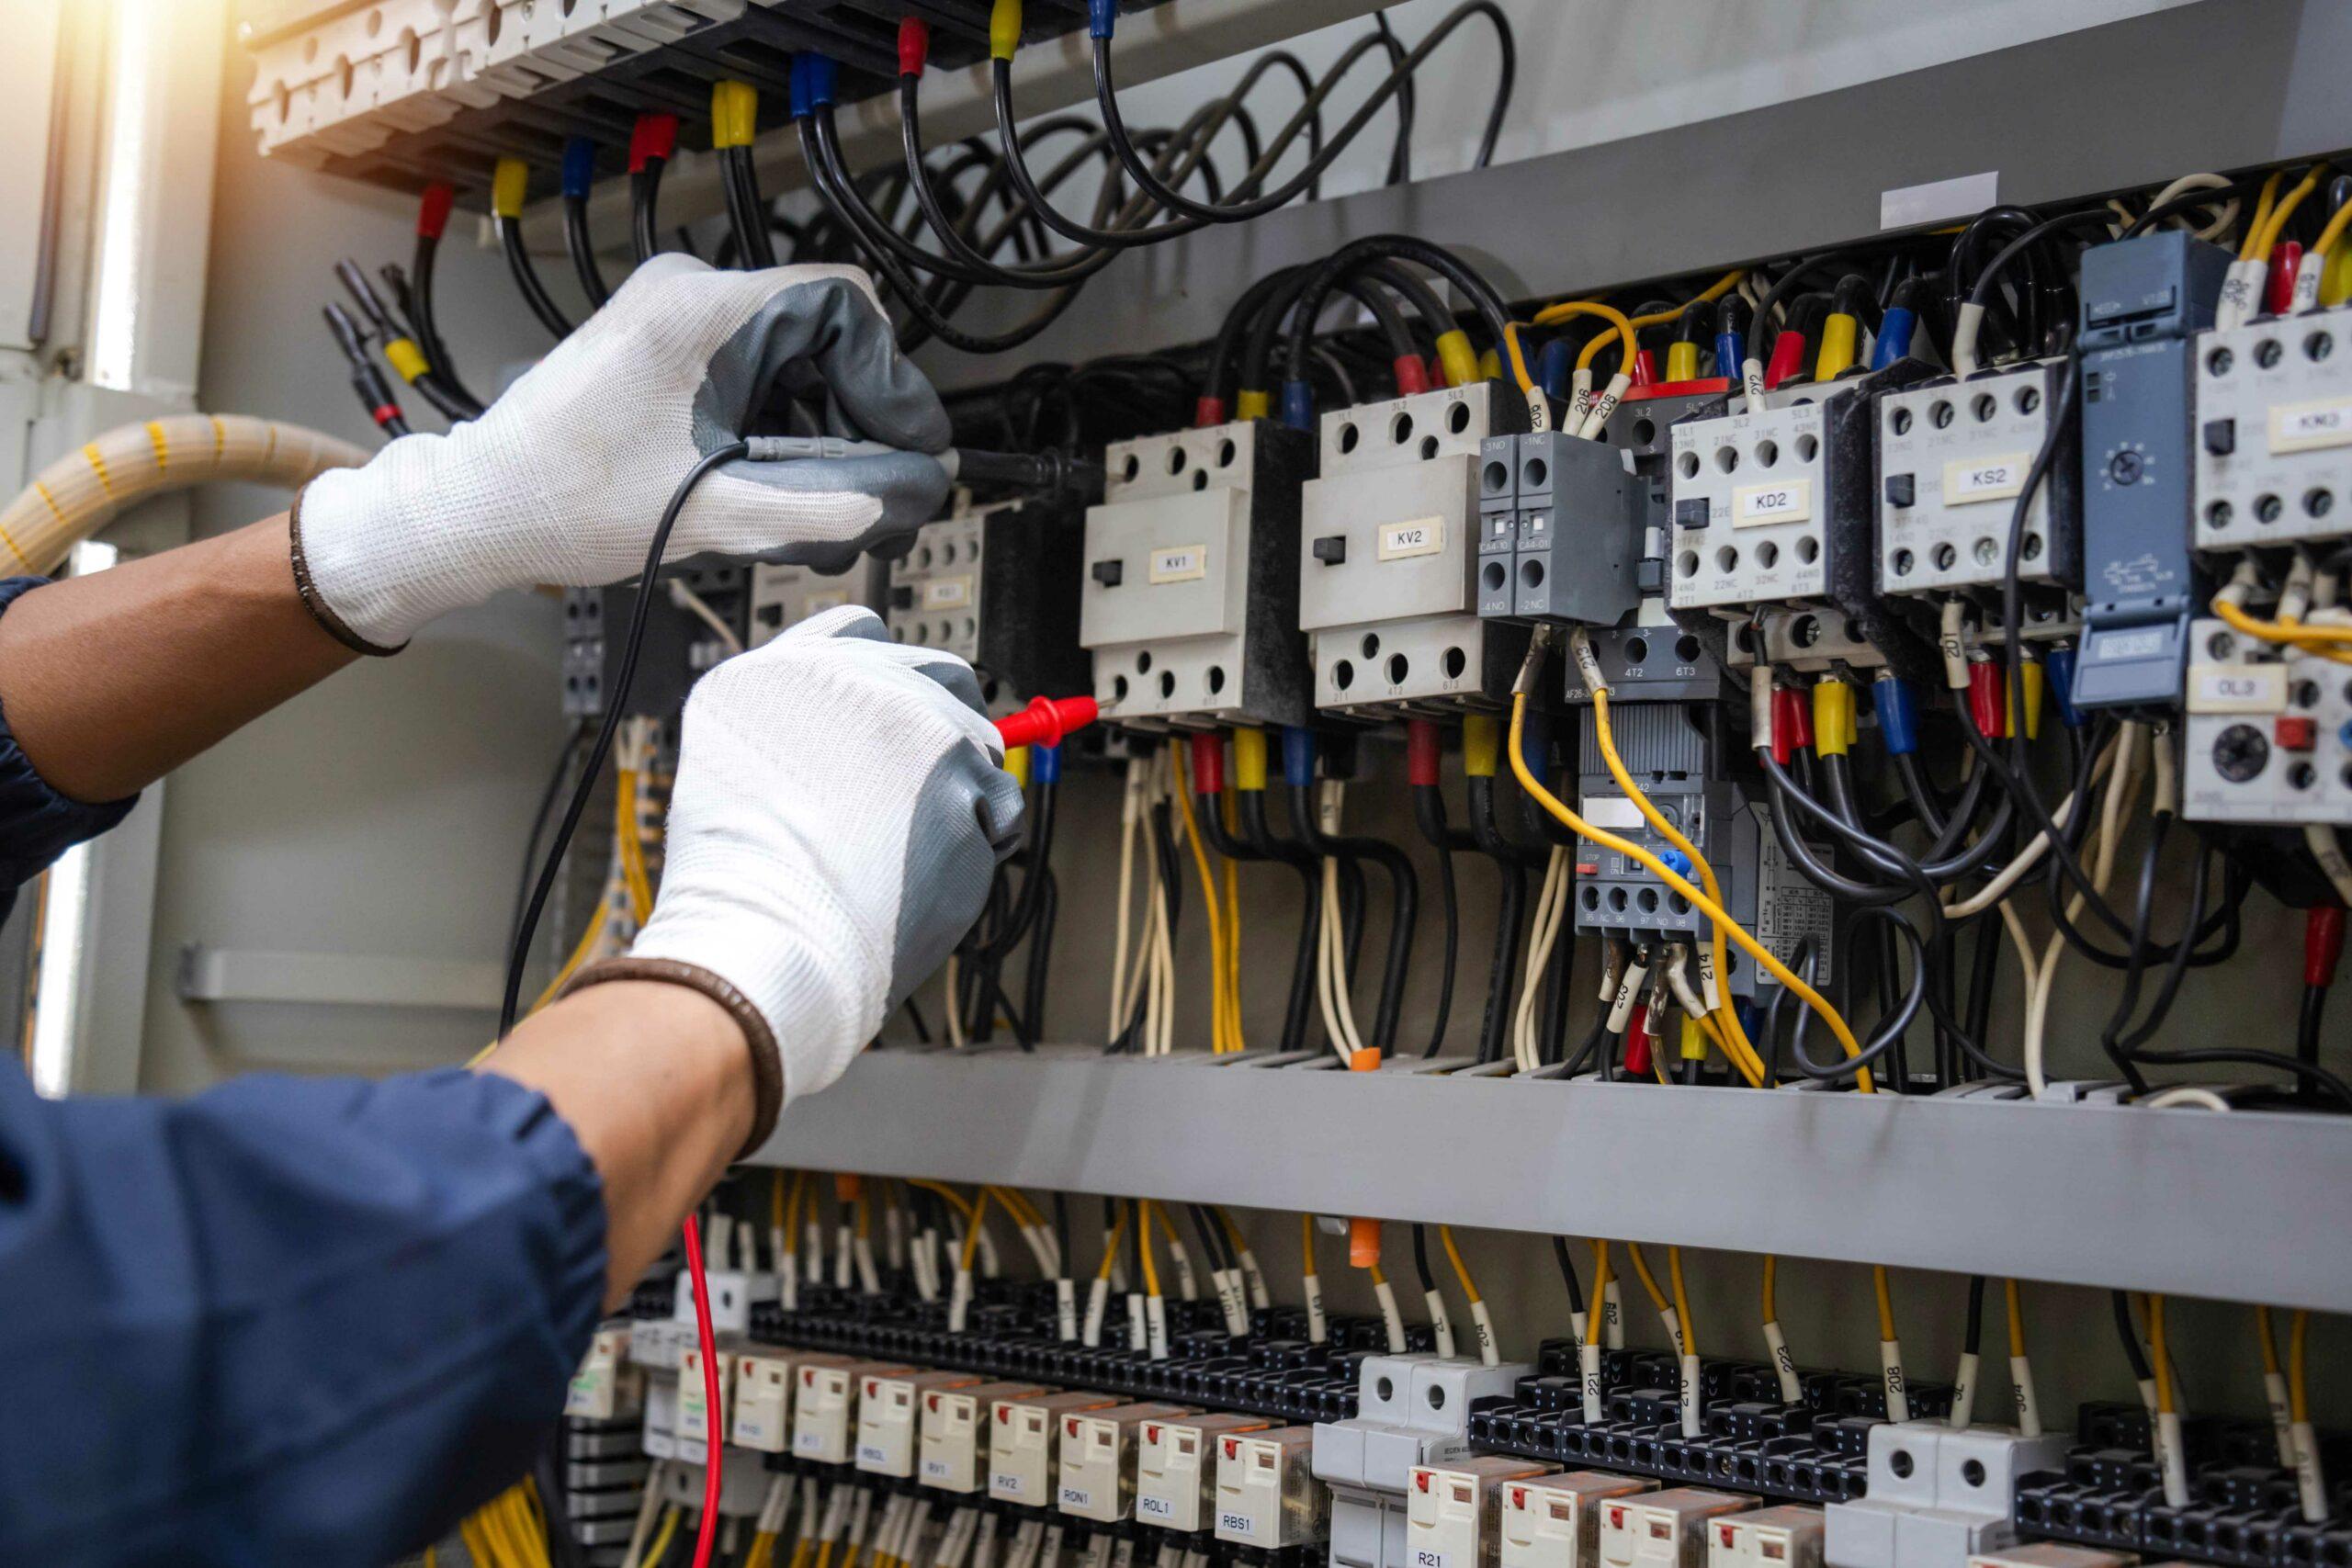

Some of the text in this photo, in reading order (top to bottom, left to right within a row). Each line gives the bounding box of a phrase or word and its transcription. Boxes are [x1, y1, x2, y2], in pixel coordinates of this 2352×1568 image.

[1751, 373, 1764, 399] 2Y2
[1448, 390, 1464, 400] 5L3
[1575, 388, 1589, 415] 206
[1391, 400, 1408, 412] 3L2
[1595, 393, 1617, 420] 206
[1635, 407, 1652, 418] 3L2
[1734, 418, 1749, 429] 3L2
[1973, 468, 2007, 485] KS2
[1756, 492, 1787, 509] KD2
[1397, 530, 1422, 545] KV2
[1480, 541, 1508, 552] CA4-10
[1165, 556, 1187, 569] KV1
[1945, 631, 1960, 660] 201
[1625, 668, 1644, 678] 4T2
[1676, 666, 1696, 677] 6T3
[1387, 685, 1404, 696] 4T2
[1442, 680, 1460, 691] 6T3
[1586, 853, 1600, 862] STOP
[1610, 868, 1620, 876] ON
[1614, 914, 1625, 923] 96
[1640, 917, 1651, 926] 97
[1675, 919, 1686, 928] 98
[1699, 952, 1714, 981] 214
[1776, 1344, 1795, 1373] 223
[1588, 1372, 1600, 1396] 221
[1886, 1366, 1904, 1394] 208
[997, 1474, 1018, 1491] RV2
[1143, 1497, 1169, 1515] ROL1
[1223, 1514, 1250, 1532] RBS1
[1419, 1552, 1441, 1568] R21
